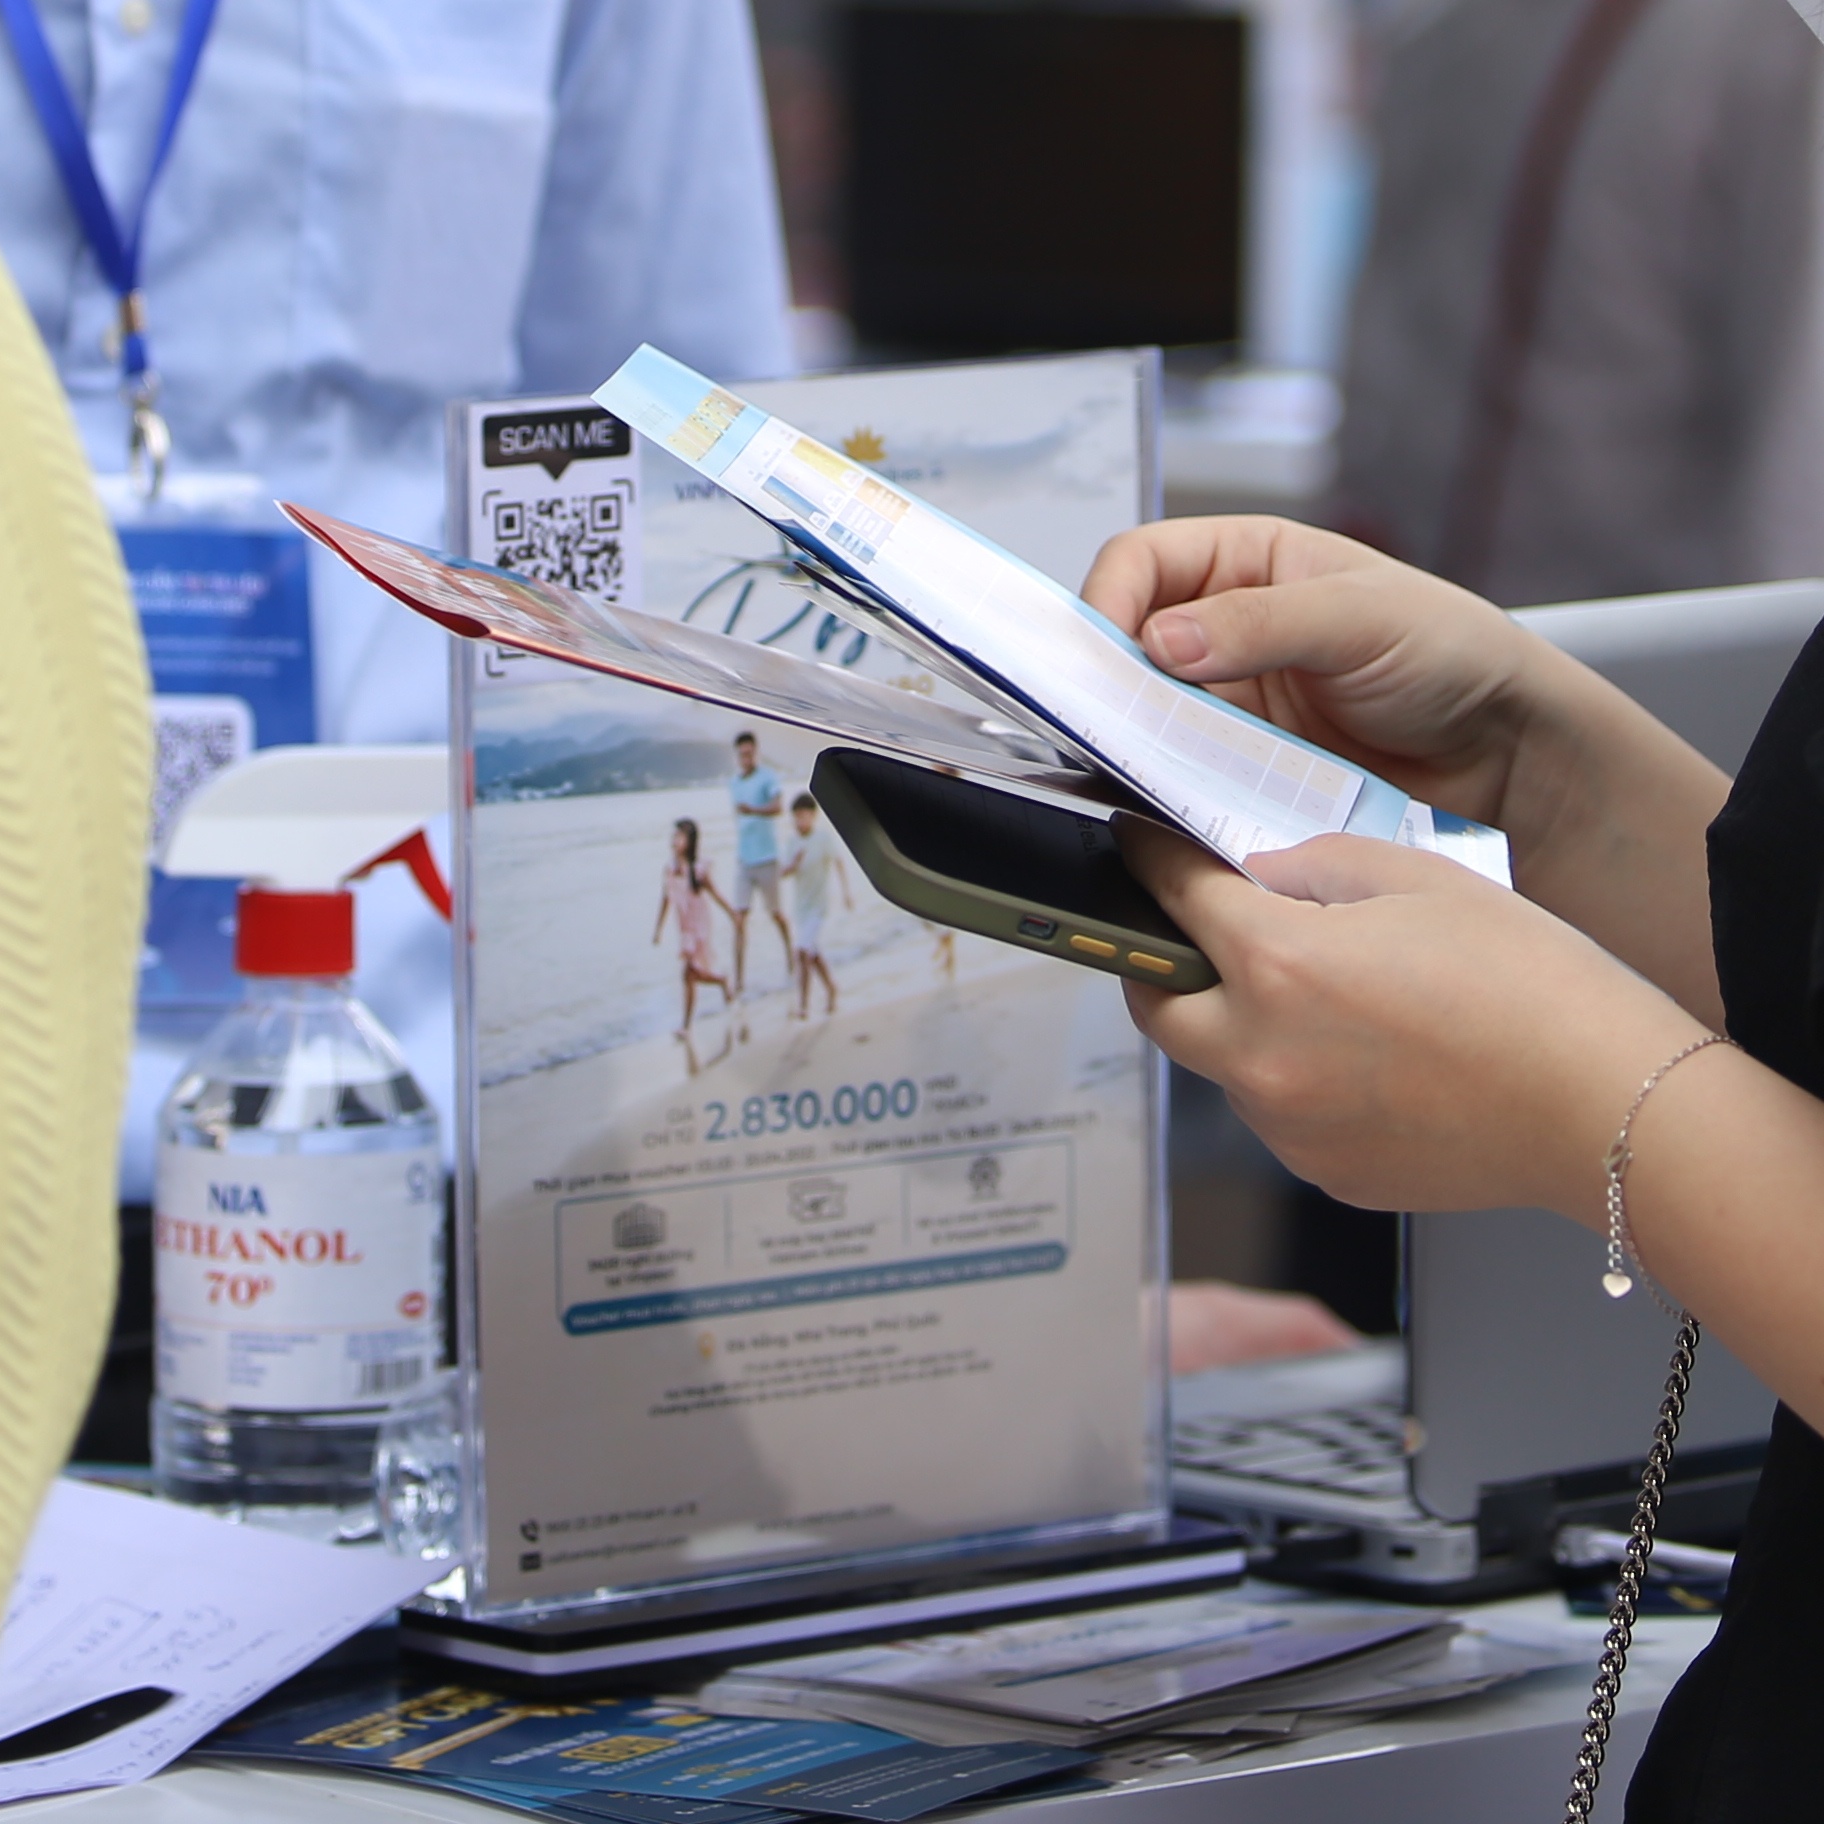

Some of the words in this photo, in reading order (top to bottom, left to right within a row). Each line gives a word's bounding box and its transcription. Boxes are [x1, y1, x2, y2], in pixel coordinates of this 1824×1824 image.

[499, 423, 570, 456] SCAN
[574, 418, 615, 447] ME
[703, 1078, 917, 1142] 2.830.000
[208, 1182, 269, 1217] NIA
